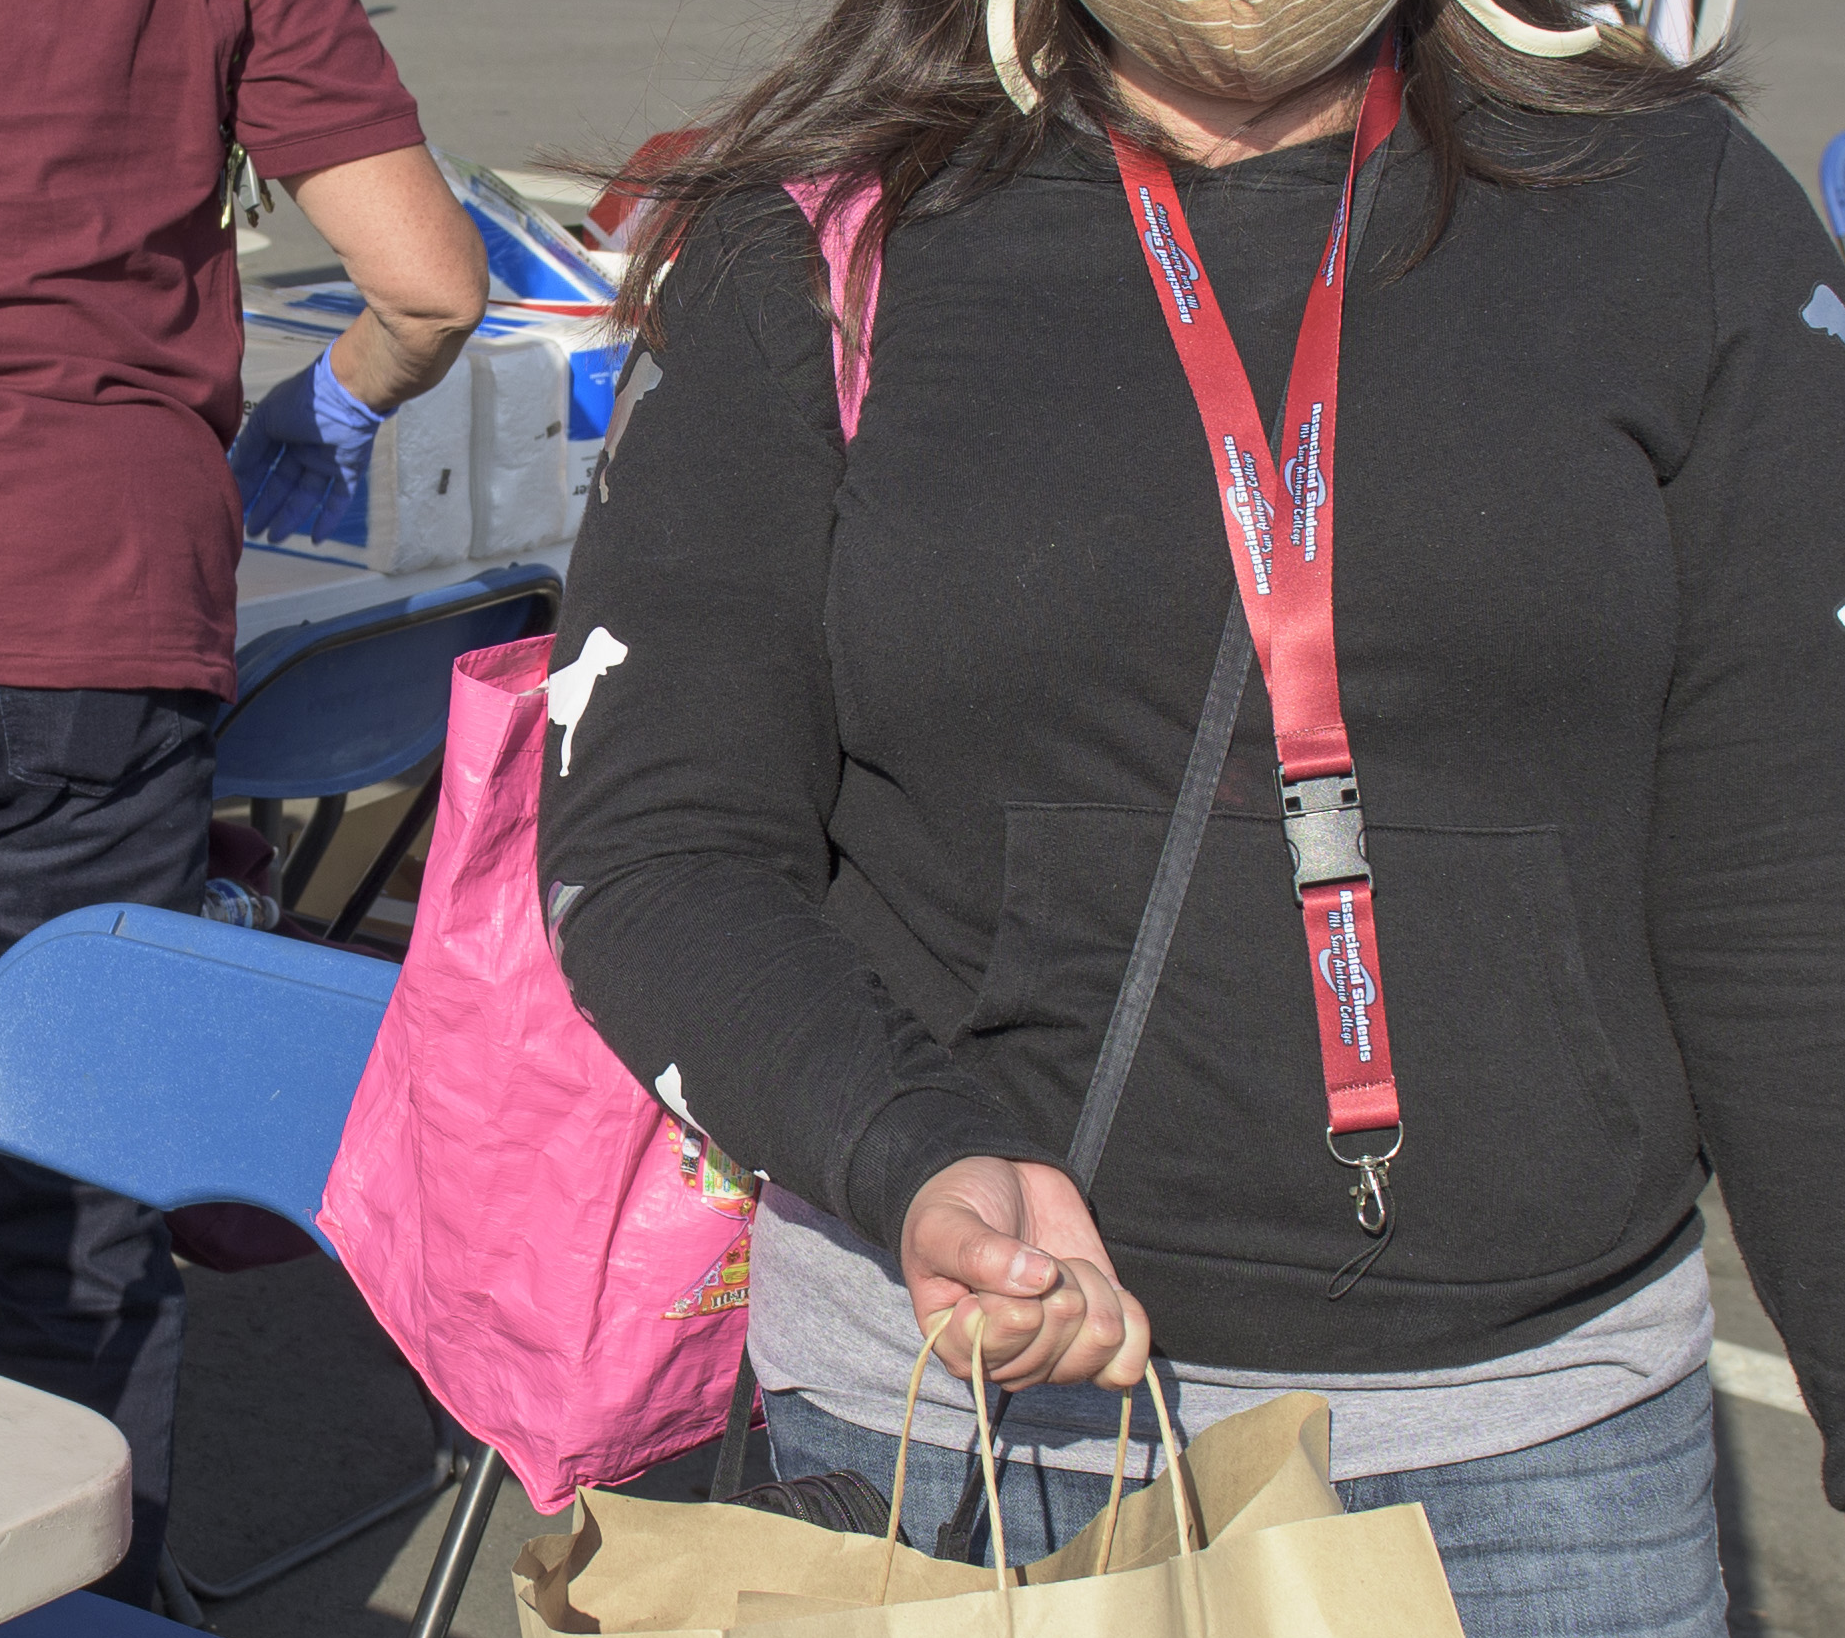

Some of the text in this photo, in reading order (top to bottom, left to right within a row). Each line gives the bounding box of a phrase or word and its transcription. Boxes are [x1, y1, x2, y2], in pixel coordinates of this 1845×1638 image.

[1153, 201, 1173, 236] College
[1137, 186, 1192, 325] Associated Students
[1165, 237, 1185, 273] Antonio
[1178, 274, 1192, 291] San
[1241, 450, 1259, 488] College
[1297, 444, 1305, 461] San
[1293, 466, 1305, 504] Antonio
[1304, 402, 1321, 560] Associated Students
[1222, 434, 1270, 596] Associated Students
[1251, 489, 1270, 532] Antonio
[1290, 508, 1304, 546] College
[1259, 533, 1272, 553] San
[1327, 909, 1357, 1046] Mt. San Antonio College
[1339, 889, 1373, 1062] Associated Students
